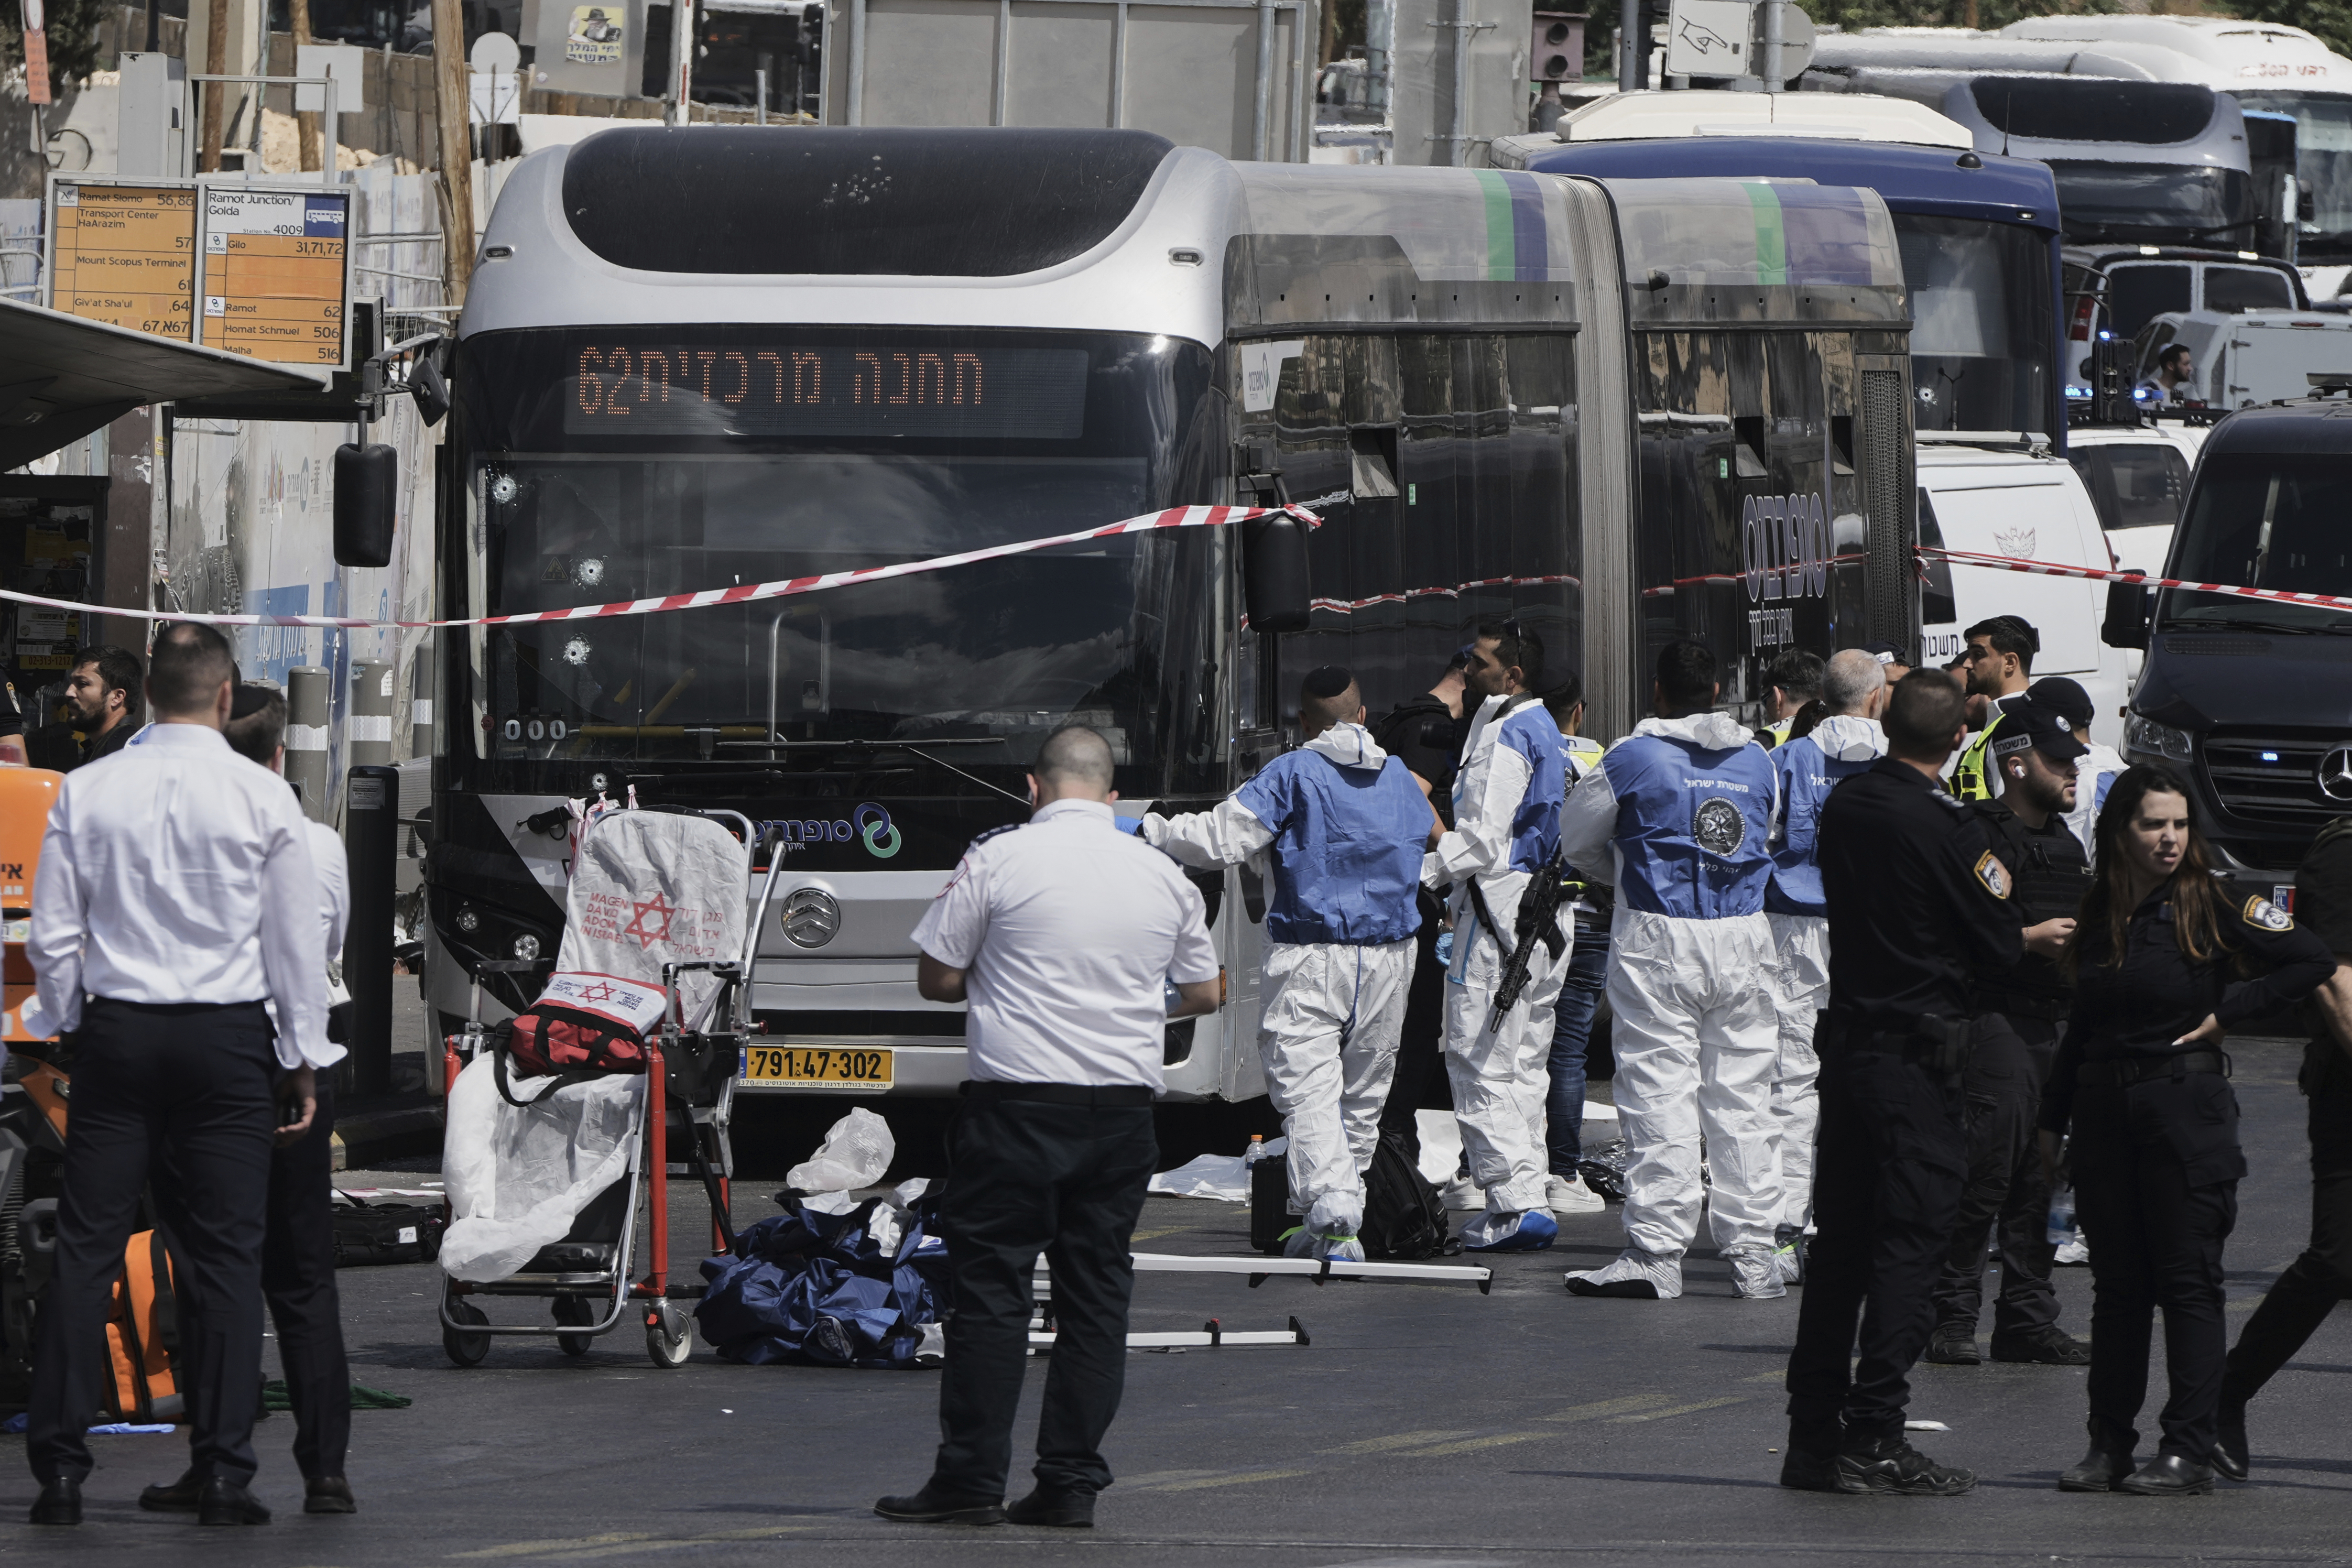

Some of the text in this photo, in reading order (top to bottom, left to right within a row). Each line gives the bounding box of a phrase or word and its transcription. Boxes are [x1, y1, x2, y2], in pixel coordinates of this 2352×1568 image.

[568, 42, 597, 52] המלך
[79, 192, 111, 202] Ramat
[114, 194, 143, 203] Slomo
[157, 193, 194, 209] 56,86
[209, 193, 296, 206] Ramot Junction/
[79, 209, 159, 220] Transport Center
[209, 205, 239, 216] Golda
[79, 219, 126, 228] HaArazim
[273, 224, 302, 235] 4009
[176, 237, 192, 248] 57
[228, 240, 344, 257] Gilo 31,71,72
[77, 256, 187, 268] Mount Scopus Terminal
[178, 279, 191, 290] 61
[75, 298, 102, 307] Giv'at
[104, 299, 133, 308] Sha'ul
[226, 303, 341, 318] Ramot 62
[225, 324, 340, 339] Homat Schmuel 506
[224, 345, 339, 360] Malha 516
[854, 353, 982, 404] תחנה
[1743, 492, 1827, 603] סופרבוס
[1748, 602, 1794, 657] איתך בכל דרך
[1920, 634, 1959, 658] משטר
[29, 656, 70, 665] 02-313-1212
[1684, 778, 1749, 793] משטרת ישראל
[1811, 773, 1843, 786] שראל
[590, 892, 629, 909] MAGEN
[678, 907, 723, 924] מגן דוד
[579, 925, 624, 944] IN ISRAEL
[688, 926, 720, 940] אדום
[672, 940, 715, 957] בישראל
[616, 1000, 637, 1011] MAGEN
[622, 998, 639, 1007] DAVID
